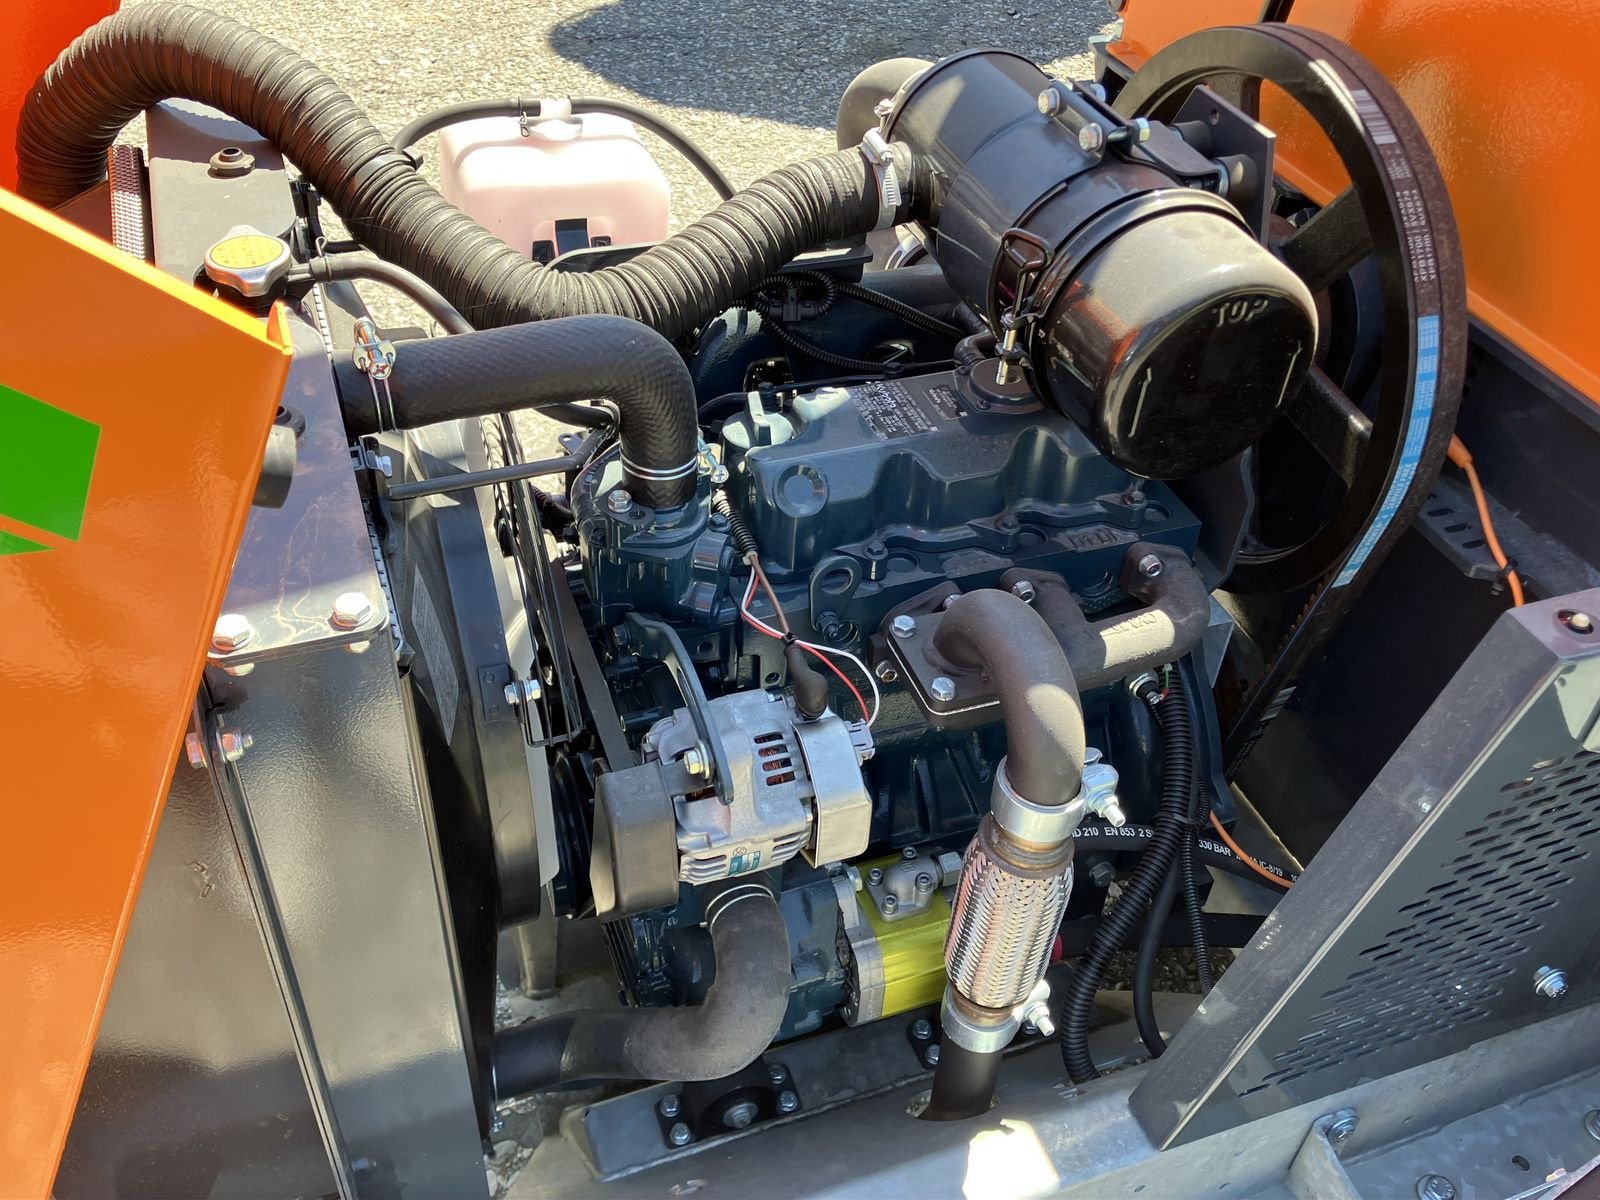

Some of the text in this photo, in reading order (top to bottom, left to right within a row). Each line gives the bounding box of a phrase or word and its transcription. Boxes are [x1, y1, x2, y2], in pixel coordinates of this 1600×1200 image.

[1211, 299, 1269, 328] TOP
[876, 383, 897, 408] Kubota
[1083, 827, 1099, 837] 210
[1104, 827, 1119, 836] EN
[1120, 827, 1135, 837] 853
[1138, 828, 1145, 838] 2
[1145, 829, 1153, 838] S
[1198, 839, 1232, 857] 330 BAR
